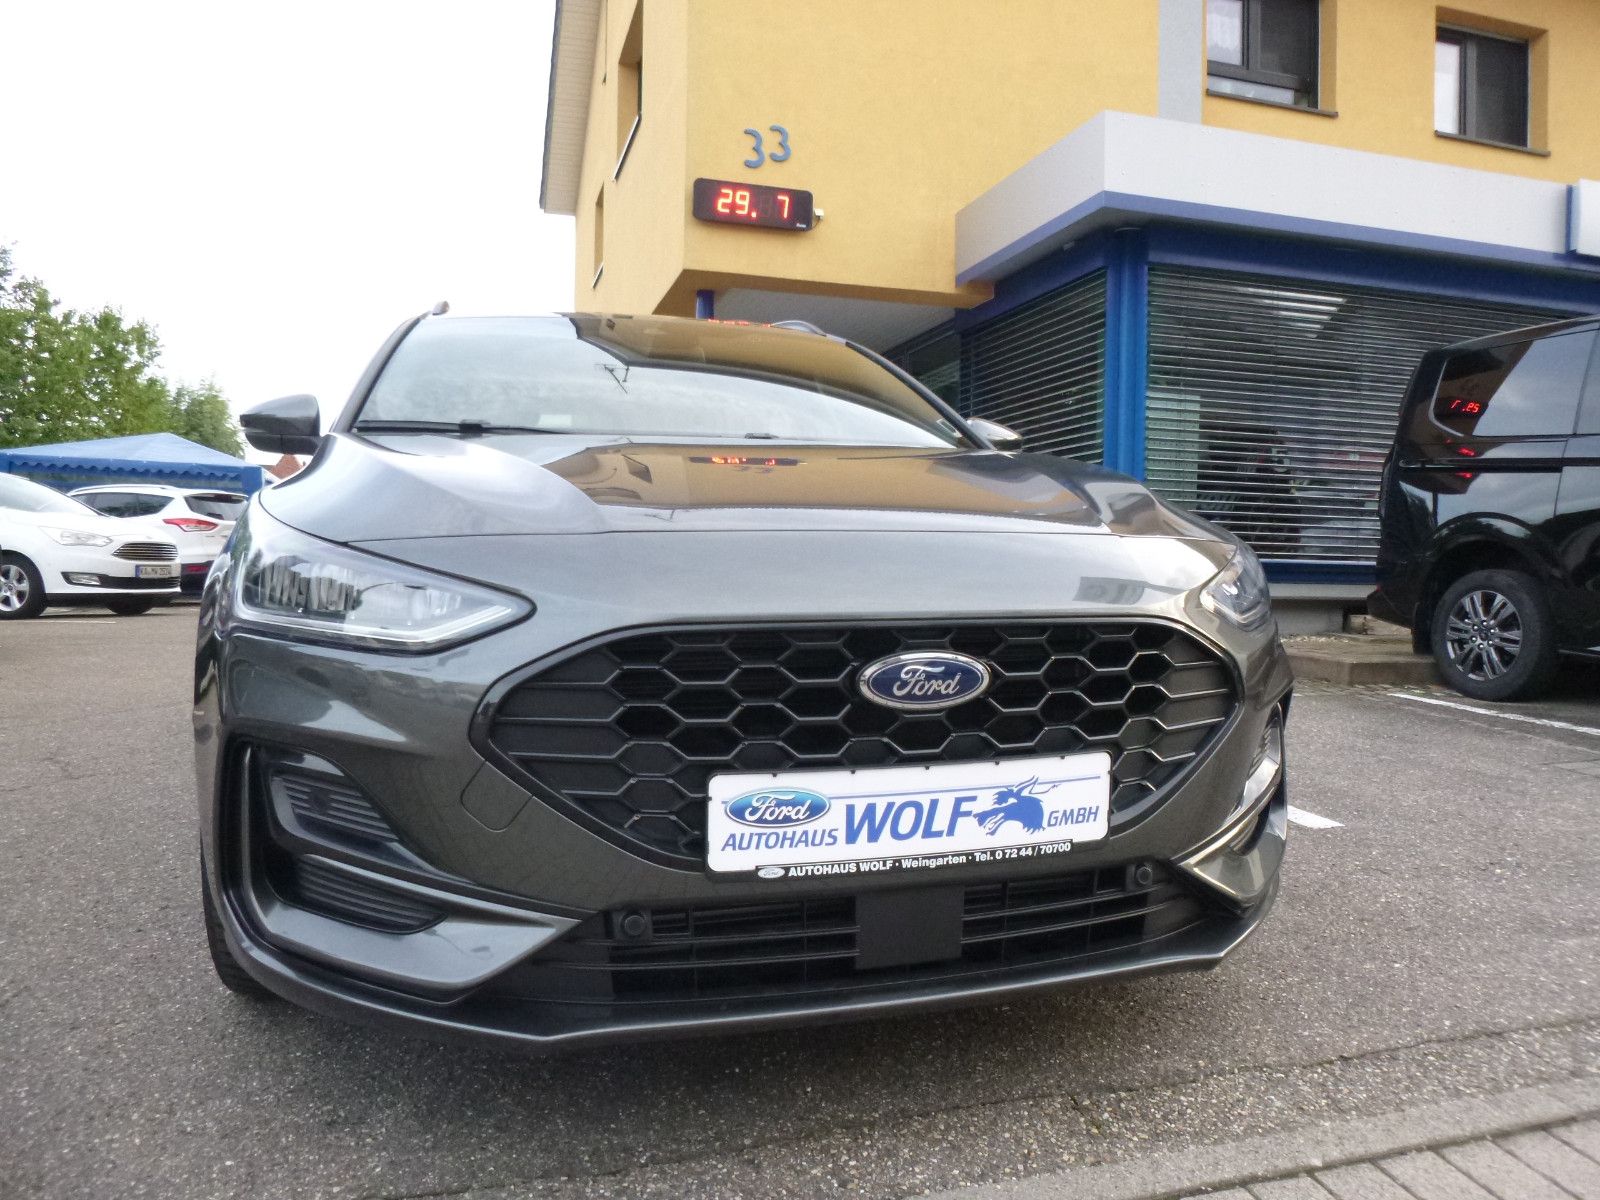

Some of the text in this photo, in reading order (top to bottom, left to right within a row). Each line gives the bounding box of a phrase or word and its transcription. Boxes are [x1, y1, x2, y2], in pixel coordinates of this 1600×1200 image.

[743, 124, 792, 169] 33
[716, 188, 790, 219] 29. 7
[893, 665, 961, 697] Ford
[721, 796, 1100, 852] AUTOHAUS WOLF GMBH
[744, 794, 812, 822] Ford
[788, 862, 857, 877] AUTOHAUS
[859, 860, 894, 872] WOLF
[901, 855, 967, 869] Weingarten
[974, 851, 994, 862] Tel.
[1040, 842, 1072, 854] 70700
